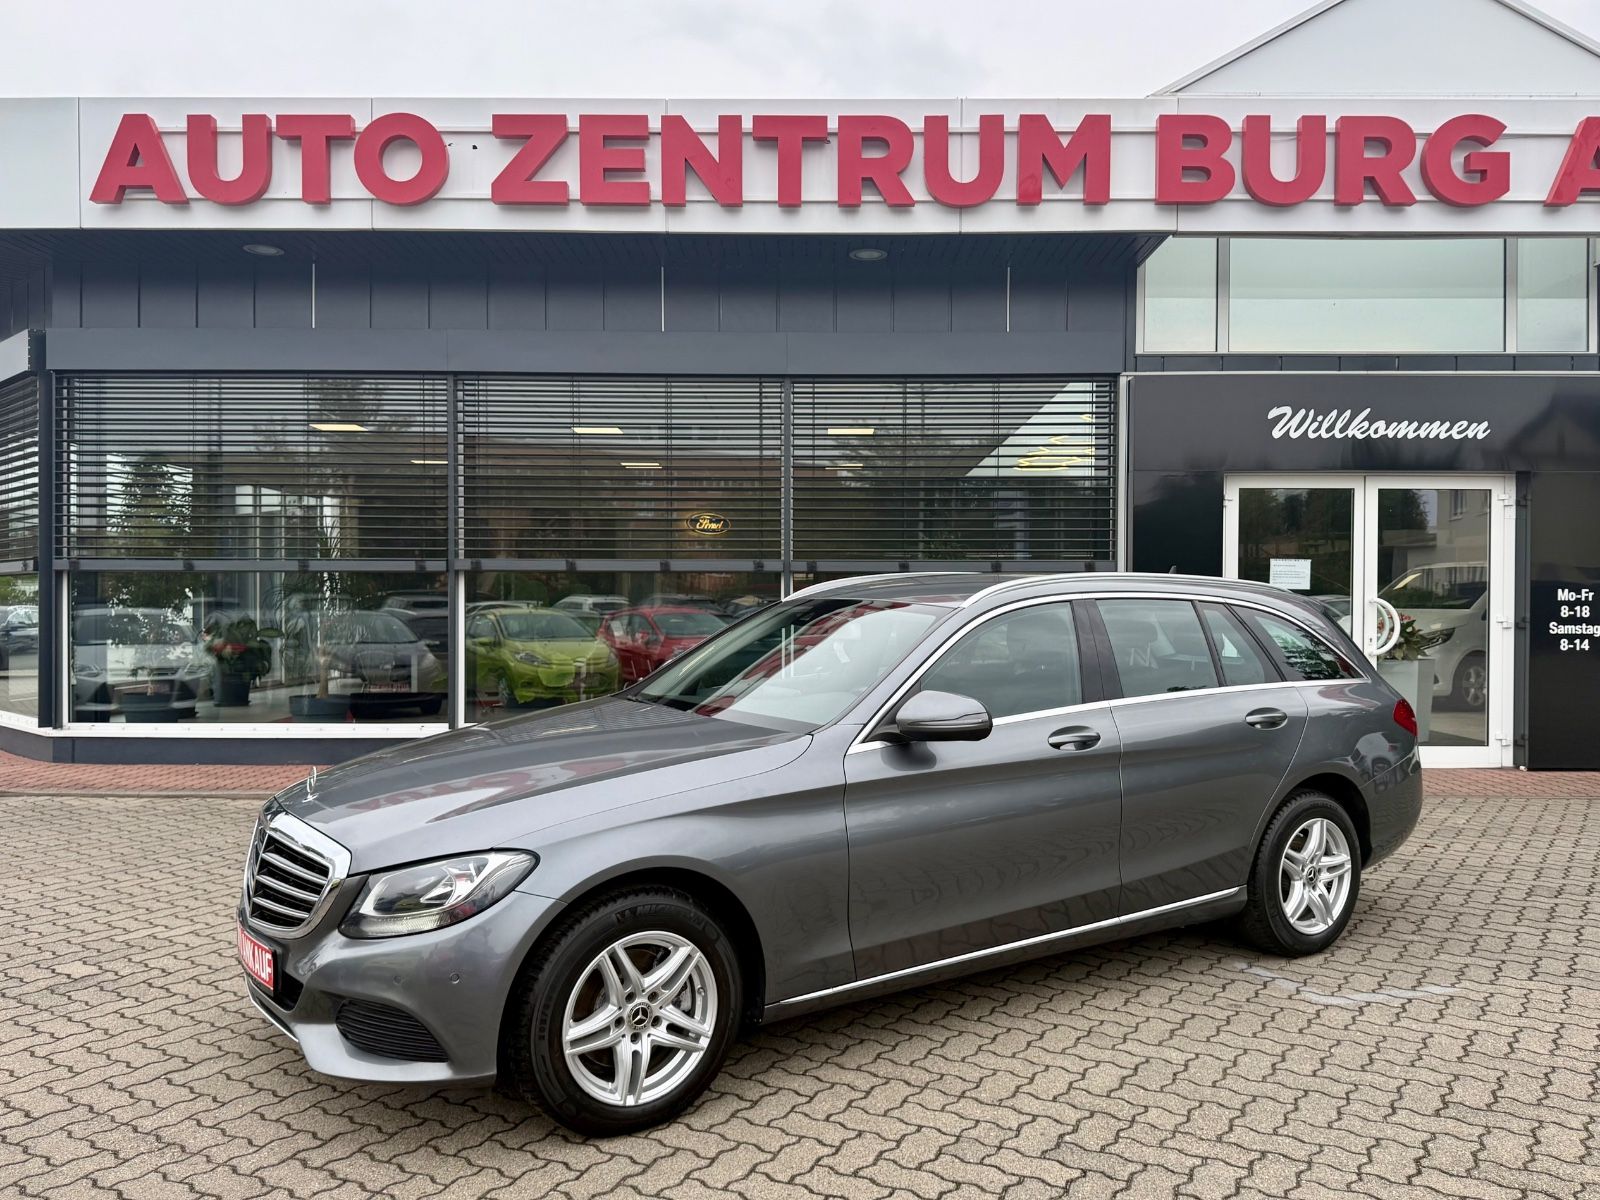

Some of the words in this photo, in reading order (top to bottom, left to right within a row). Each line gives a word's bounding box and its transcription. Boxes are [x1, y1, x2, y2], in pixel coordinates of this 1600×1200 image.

[89, 112, 449, 206] AUTO
[491, 113, 1112, 208] ZENTRUM
[1154, 113, 1511, 208] BURG
[1543, 116, 1600, 207] A
[1267, 405, 1491, 440] Willkommen
[1557, 588, 1594, 601] Mo-Fr
[1560, 605, 1590, 618] 8-18
[1549, 621, 1600, 637] Samstag
[1560, 638, 1590, 651] 8-14
